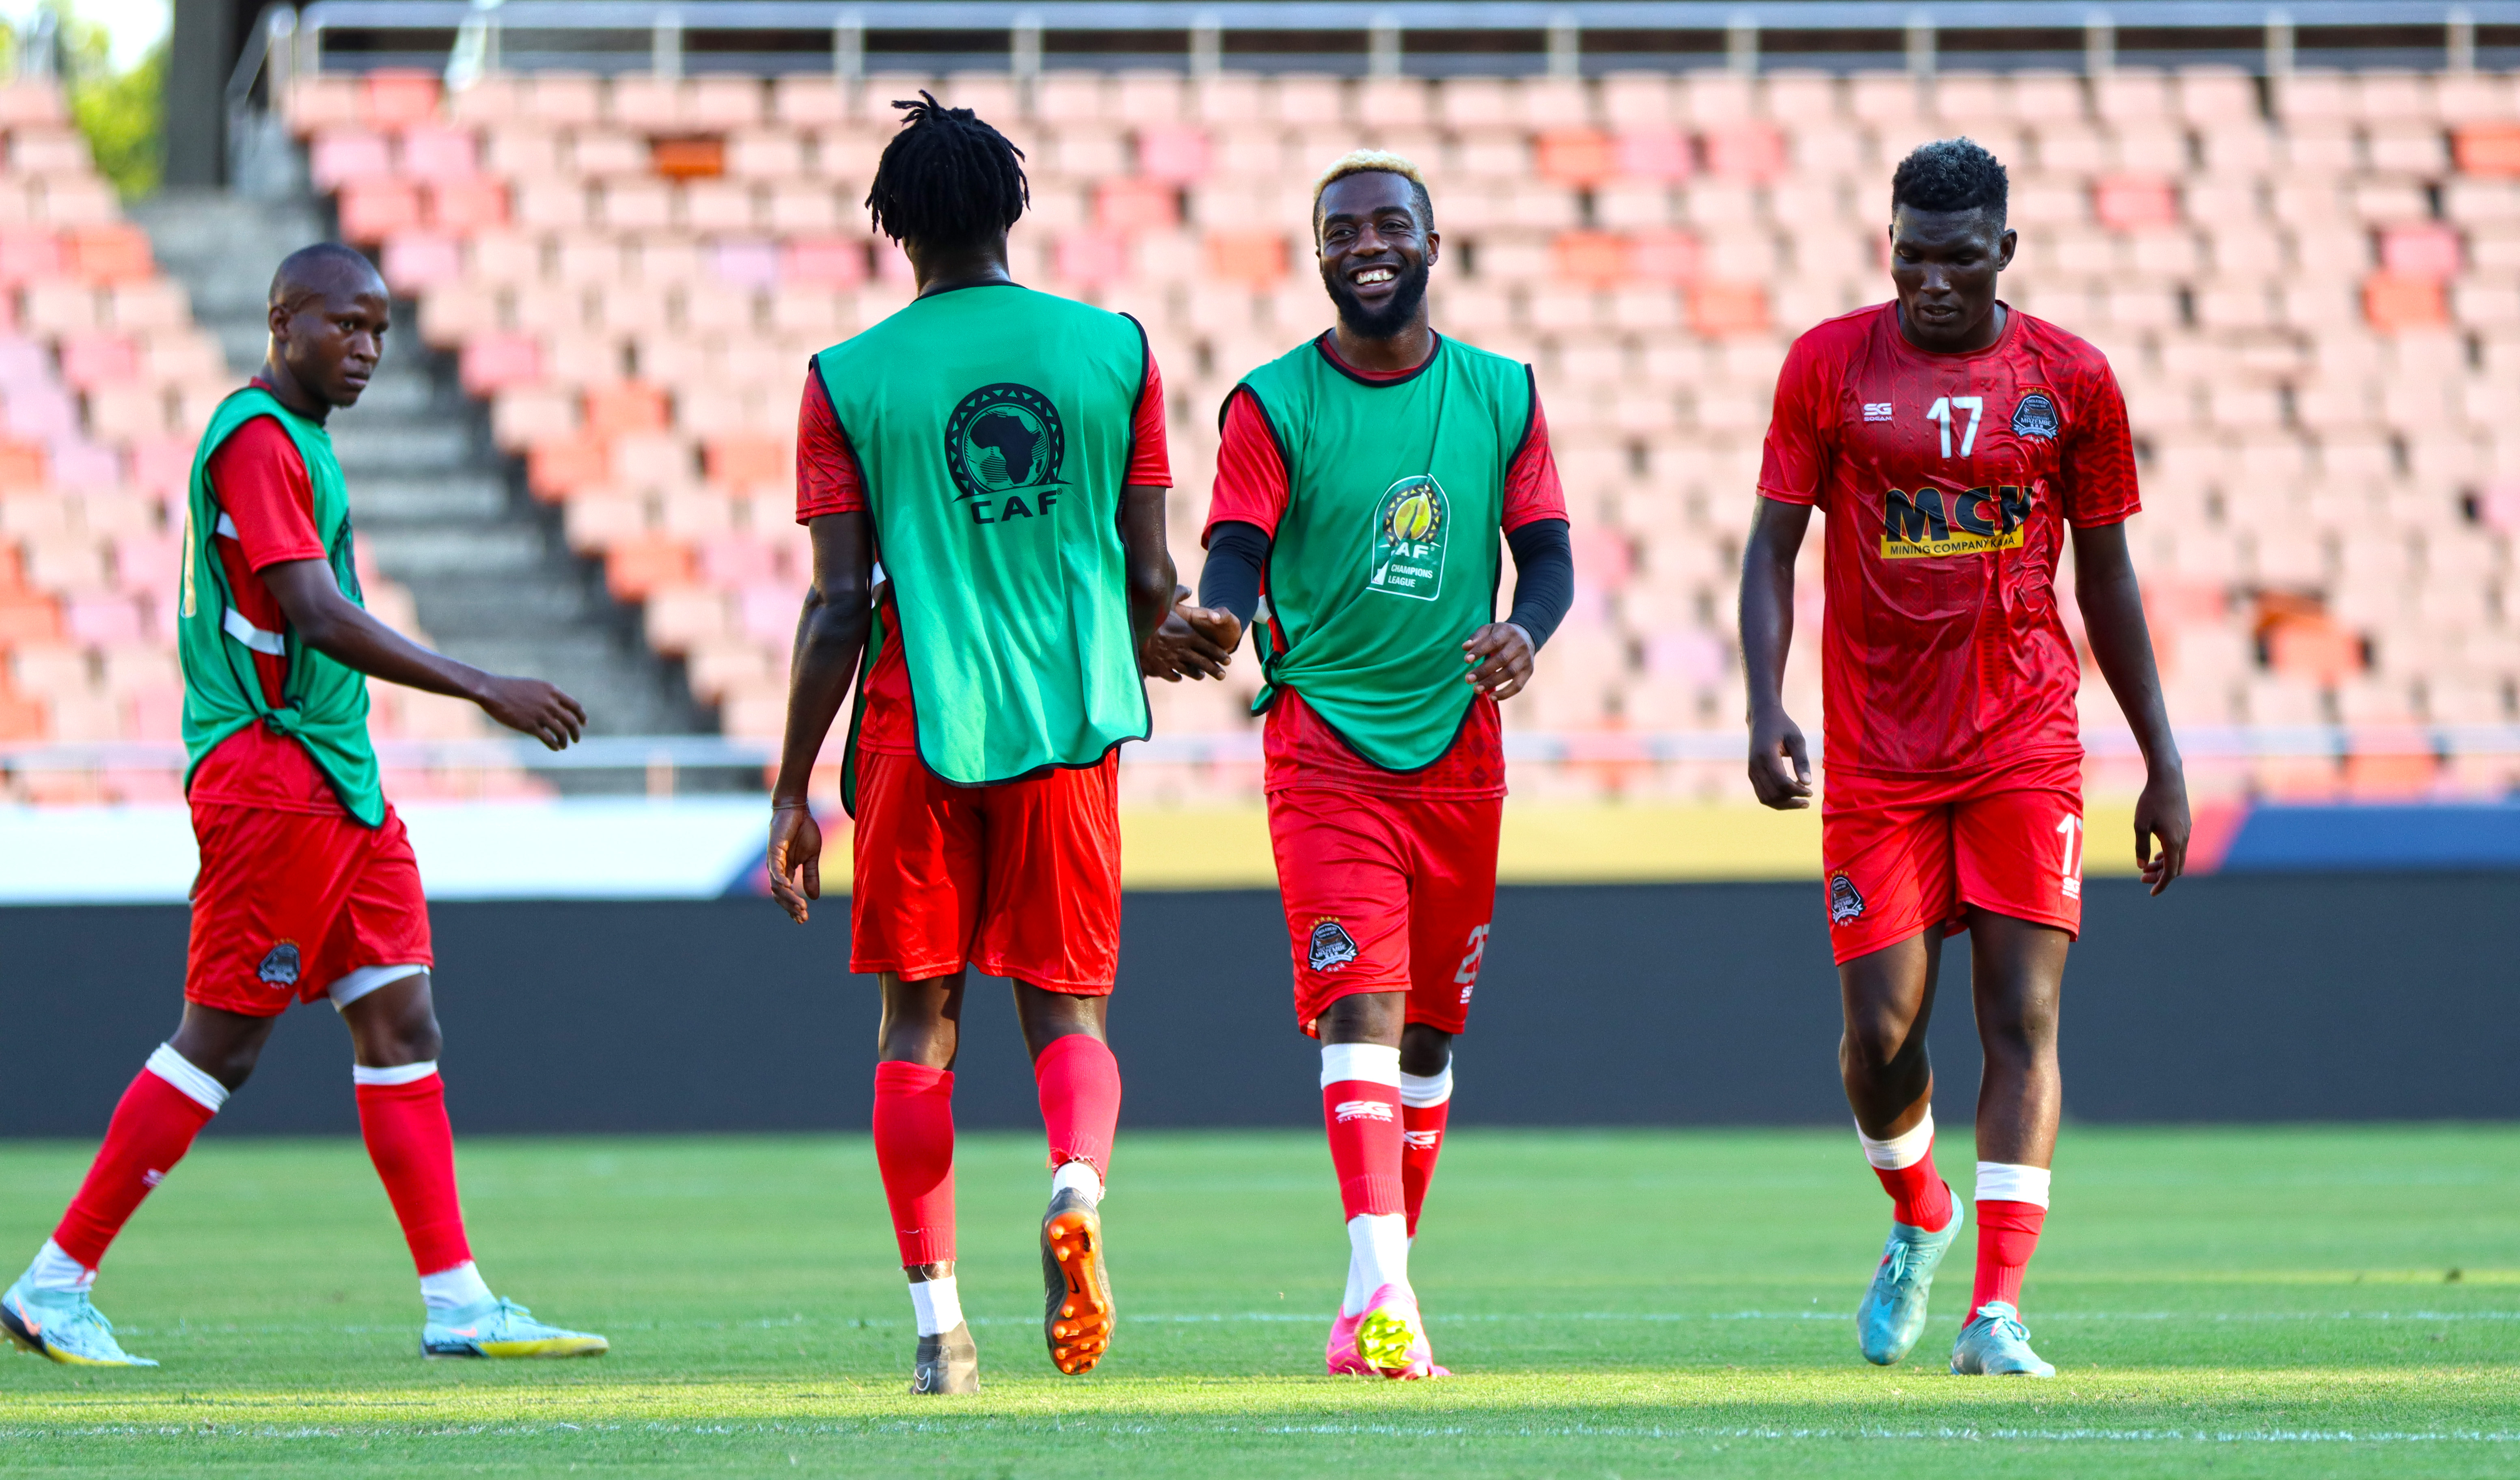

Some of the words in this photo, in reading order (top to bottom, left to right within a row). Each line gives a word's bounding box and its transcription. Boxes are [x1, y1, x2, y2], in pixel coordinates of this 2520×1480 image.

[1864, 403, 1892, 416] SG
[1926, 396, 1983, 458] 17
[2021, 417, 2052, 427] MAZEMBE
[970, 490, 1057, 524] CAF
[1391, 542, 1429, 559] AF
[1890, 545, 1931, 555] MINING
[1934, 539, 1988, 553] COMPANY
[1391, 564, 1433, 579] CHAMPIONS
[1387, 575, 1416, 588] LEAGUE
